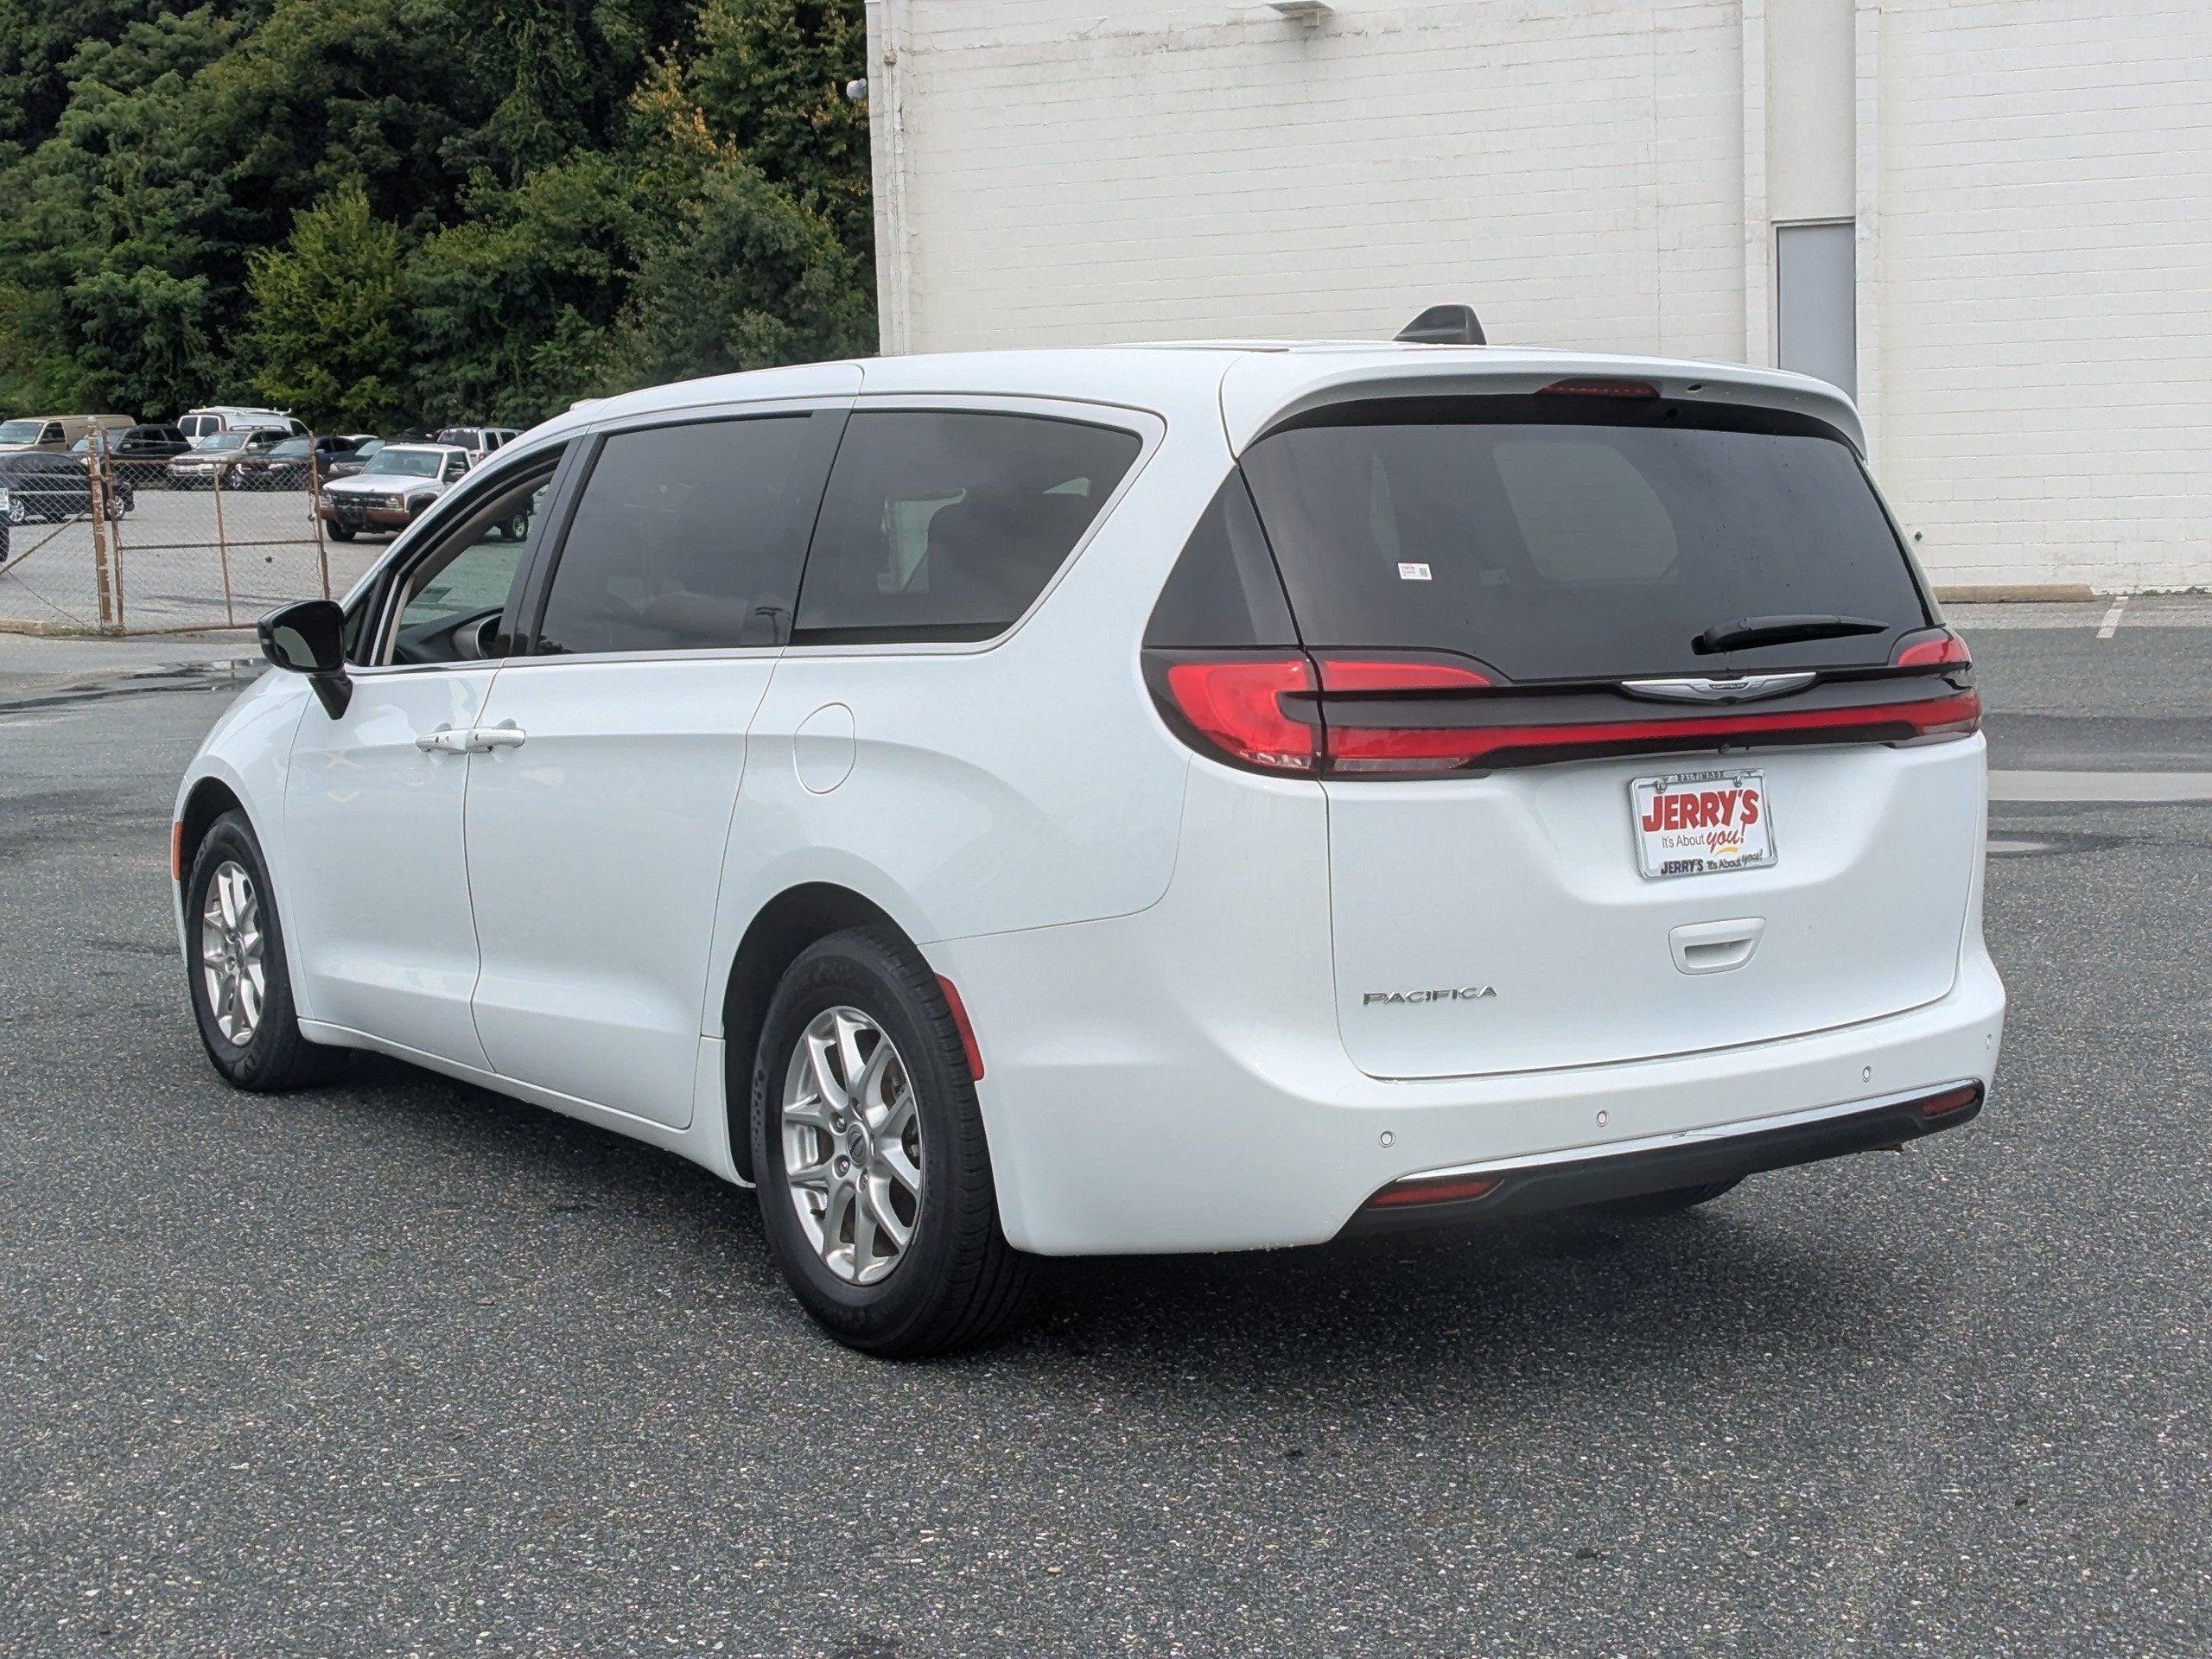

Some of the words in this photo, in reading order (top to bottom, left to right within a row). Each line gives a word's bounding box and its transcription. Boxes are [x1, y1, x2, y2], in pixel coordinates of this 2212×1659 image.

[1642, 789, 1759, 832] JERRY'S
[1662, 836, 1675, 849] It's
[1676, 833, 1705, 847] About
[1707, 823, 1745, 853] you!
[1660, 858, 1704, 874] JERRY'S
[1719, 858, 1742, 869] About
[1741, 849, 1764, 867] you!
[1363, 985, 1497, 1006] PACIFICA
